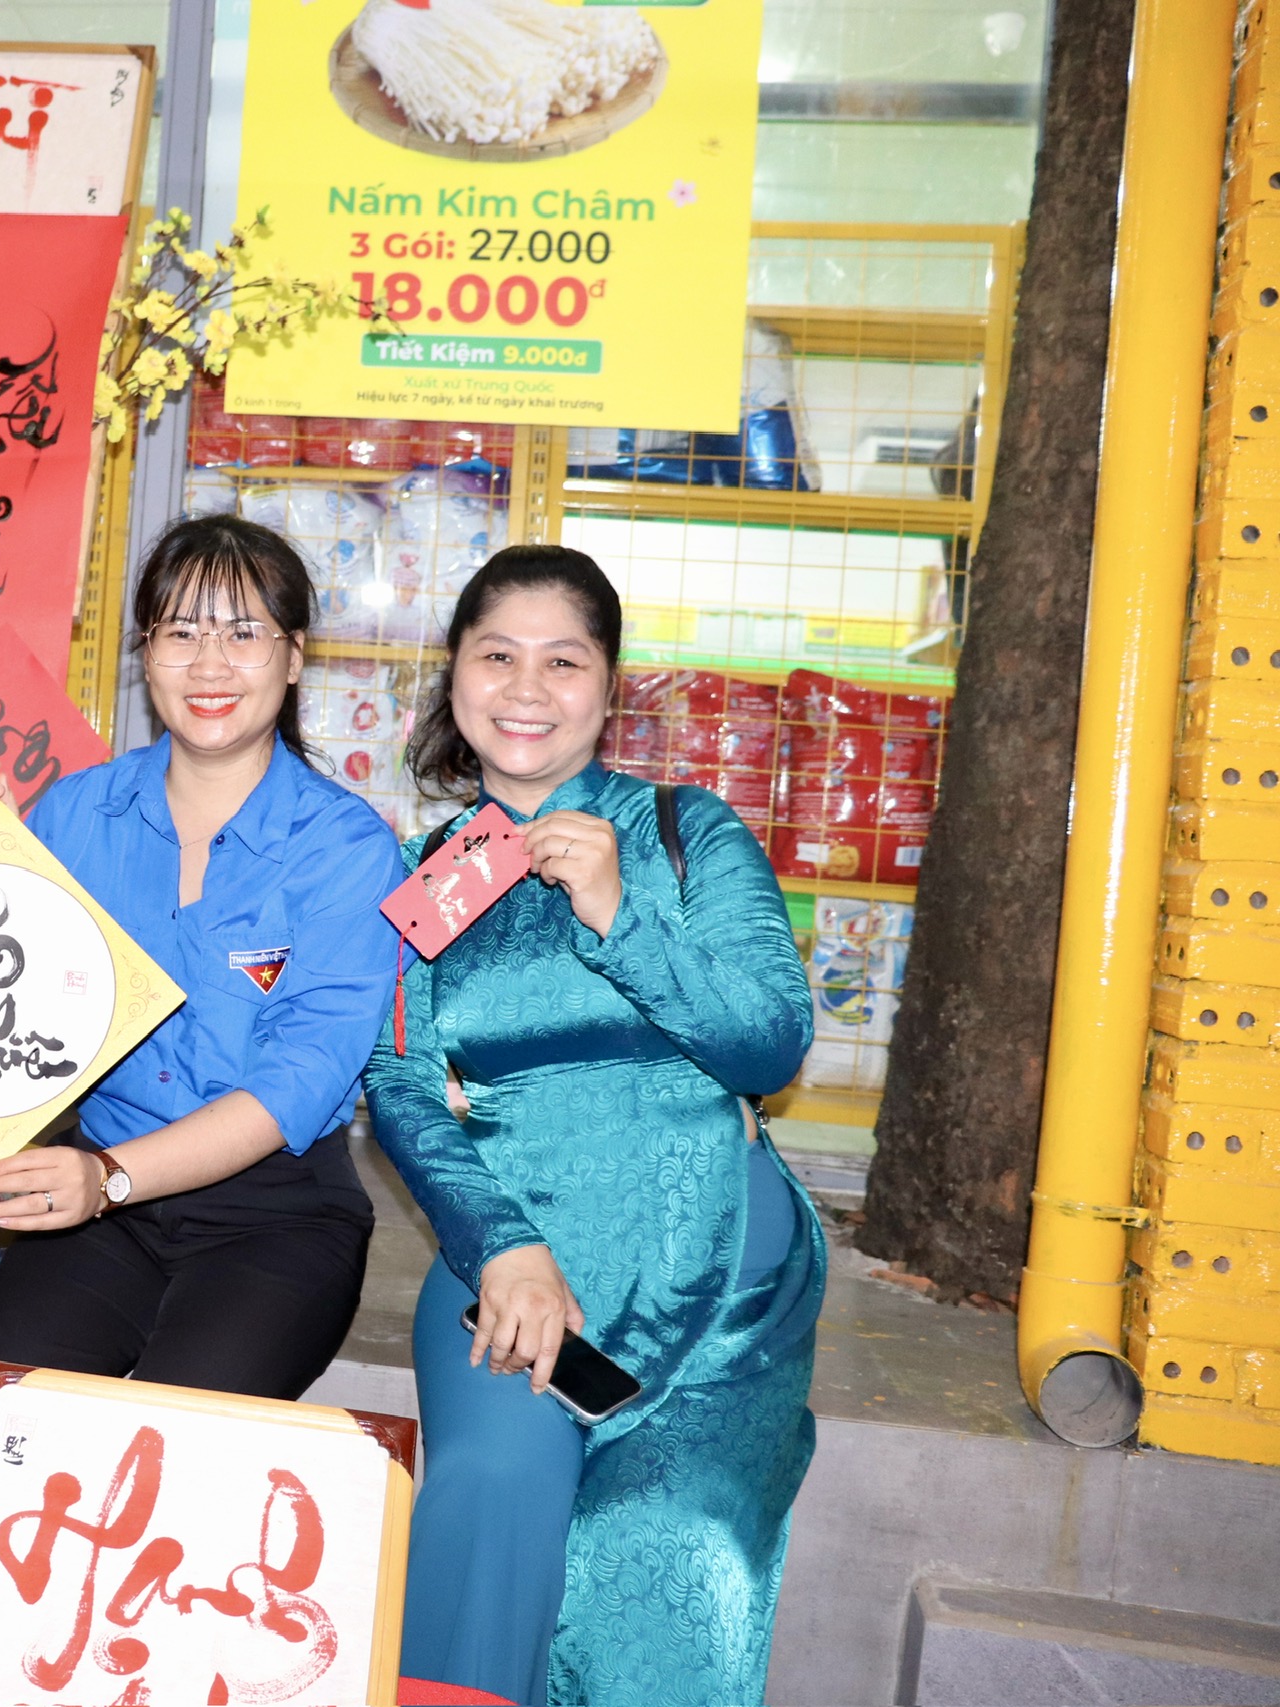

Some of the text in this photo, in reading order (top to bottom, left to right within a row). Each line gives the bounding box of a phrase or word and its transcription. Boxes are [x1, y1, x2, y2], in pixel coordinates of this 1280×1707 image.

[329, 182, 655, 221] Nấm Kim Châm
[349, 228, 612, 265] 3 Gói: 27.000
[375, 339, 424, 361] Tiết
[430, 341, 496, 367] Kiệm
[404, 375, 437, 389] Xuất
[465, 378, 509, 393] Trung
[514, 378, 554, 393] Quốc
[357, 391, 385, 403] Hiệu
[388, 391, 408, 404] lực
[412, 393, 419, 402] 7
[494, 396, 525, 408] ngày
[528, 397, 556, 408] khai
